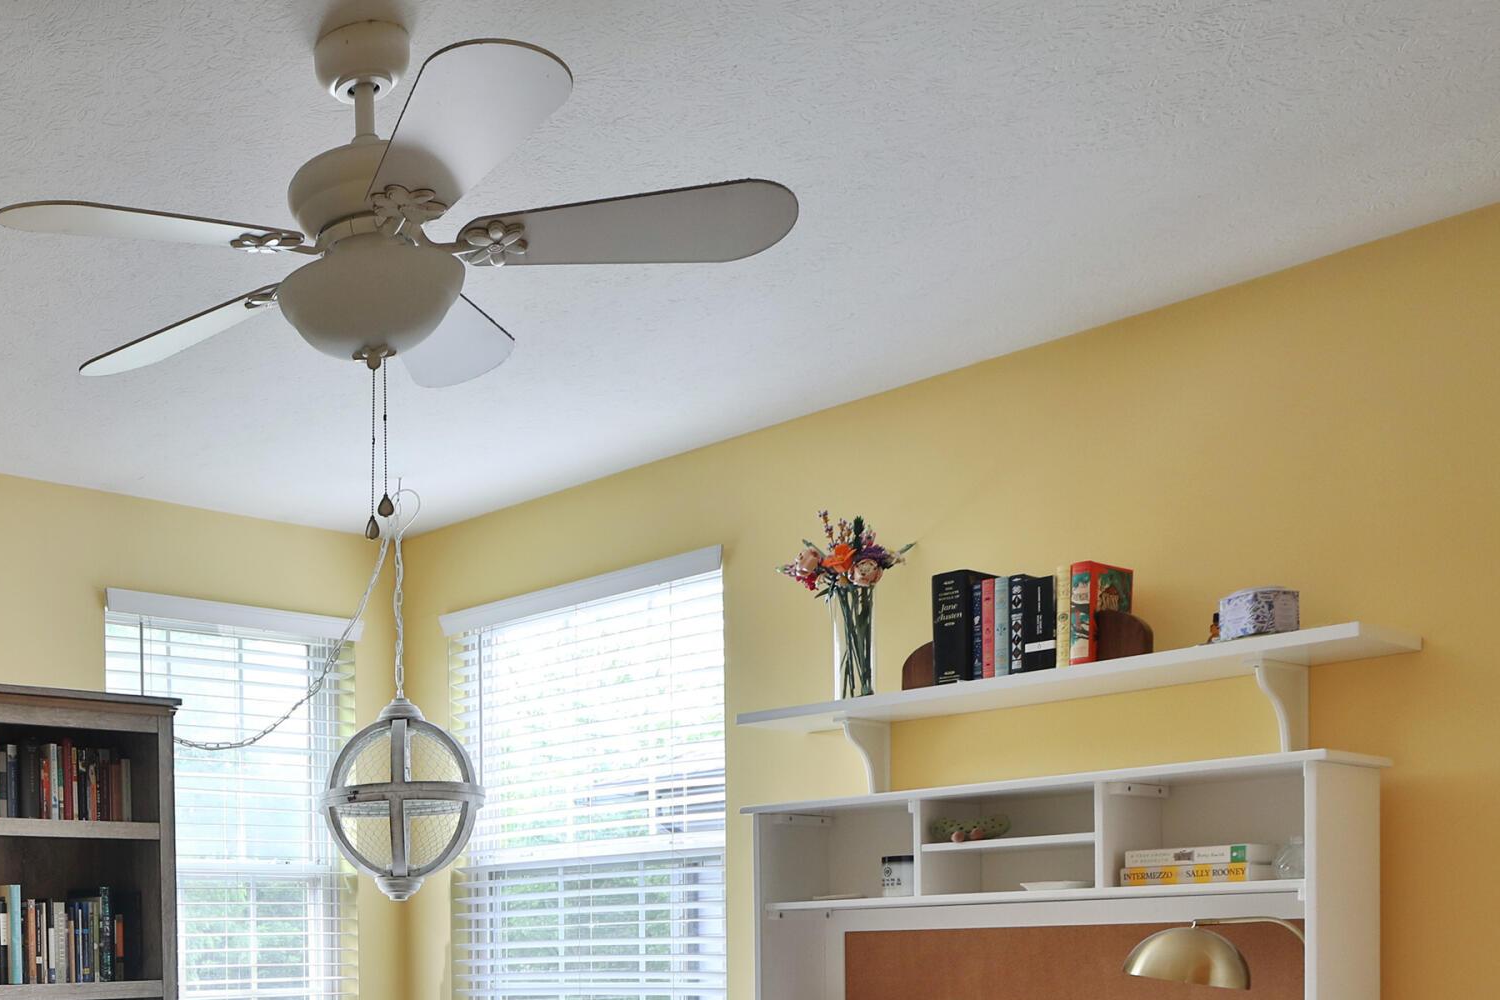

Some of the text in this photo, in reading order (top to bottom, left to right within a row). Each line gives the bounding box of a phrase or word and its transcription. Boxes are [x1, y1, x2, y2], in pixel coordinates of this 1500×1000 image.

[939, 603, 958, 613] Jane
[937, 612, 963, 622] Austen
[1123, 867, 1246, 881] INTERMEZZO SALLY ROONEY
